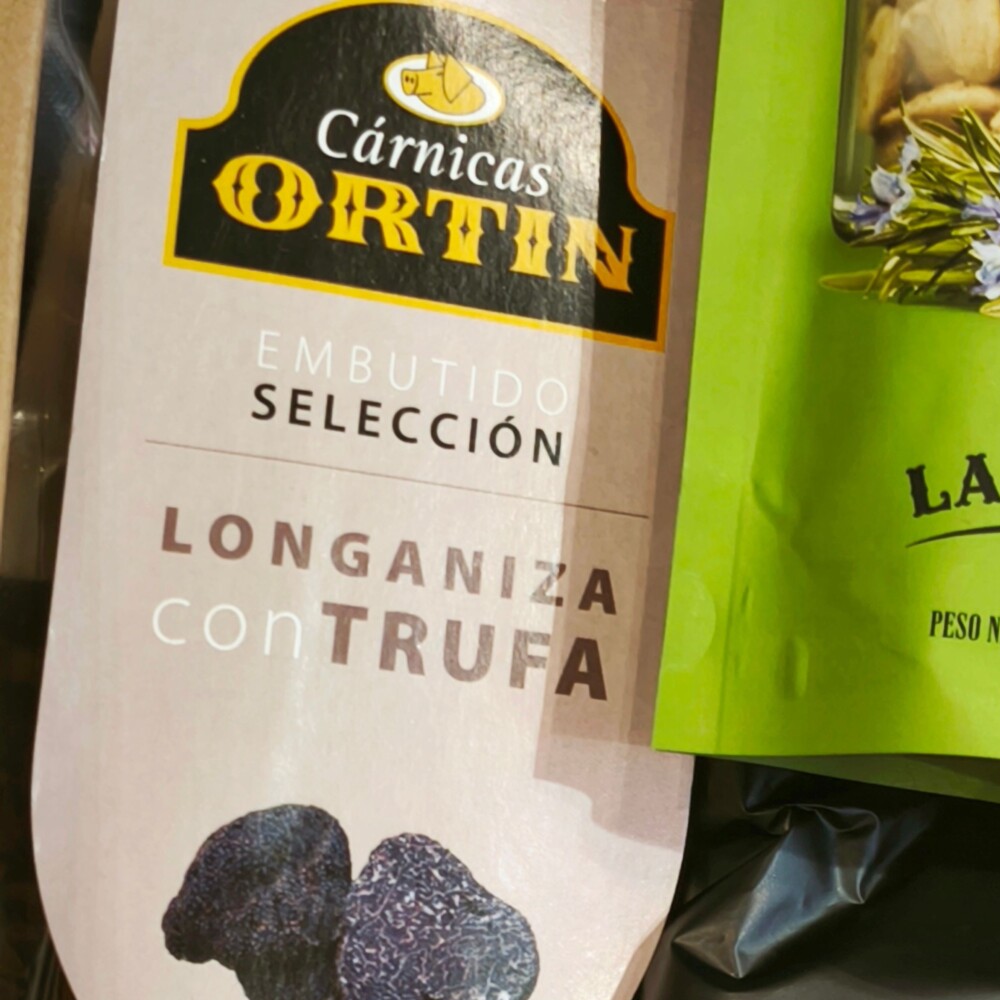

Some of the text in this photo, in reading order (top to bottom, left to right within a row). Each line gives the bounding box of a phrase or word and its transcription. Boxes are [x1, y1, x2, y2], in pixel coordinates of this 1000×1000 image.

[316, 107, 551, 197] Cárnicas
[212, 155, 637, 293] ORTIN
[257, 330, 568, 416] EMBUTIDO
[251, 384, 563, 466] SELECCIÓN
[161, 507, 617, 615] LONGANIZA
[929, 610, 981, 640] PESO
